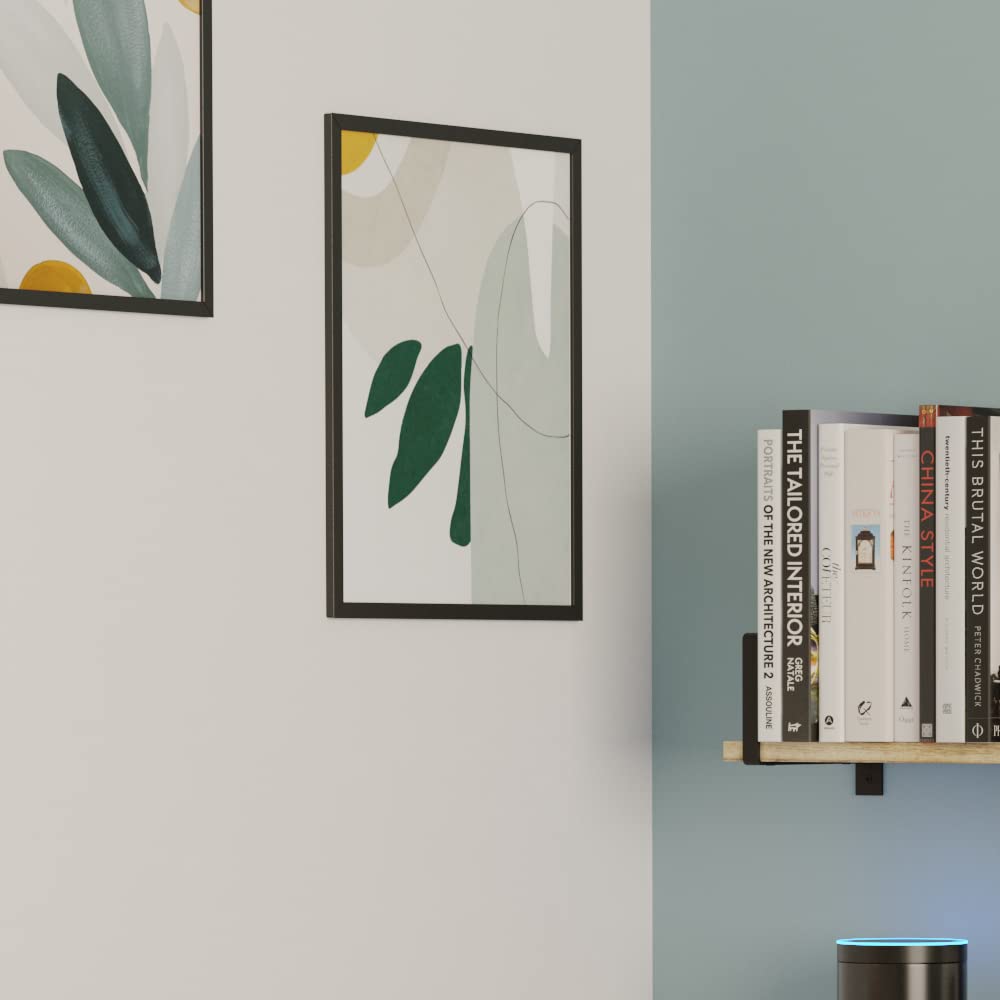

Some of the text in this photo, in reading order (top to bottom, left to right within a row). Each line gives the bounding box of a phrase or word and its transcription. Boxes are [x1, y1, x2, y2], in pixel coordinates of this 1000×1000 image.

[763, 439, 774, 502] PORTRAITS
[943, 435, 951, 511] twentieth-century
[763, 504, 774, 519] OF
[763, 523, 774, 546] THE
[786, 428, 803, 647] THE TAILORED INTERIOR
[920, 449, 935, 588] CHINA STYLE
[971, 427, 984, 616] THIS BRUTAL WORLD
[763, 549, 774, 576] NEW
[902, 545, 912, 620] KINFOLK
[763, 579, 774, 669] ARCHITECTURE
[786, 657, 795, 692] NATALE
[795, 657, 803, 682] GREG
[974, 626, 982, 707] PETER CHADWICK
[765, 686, 773, 729] ASSOULINE
